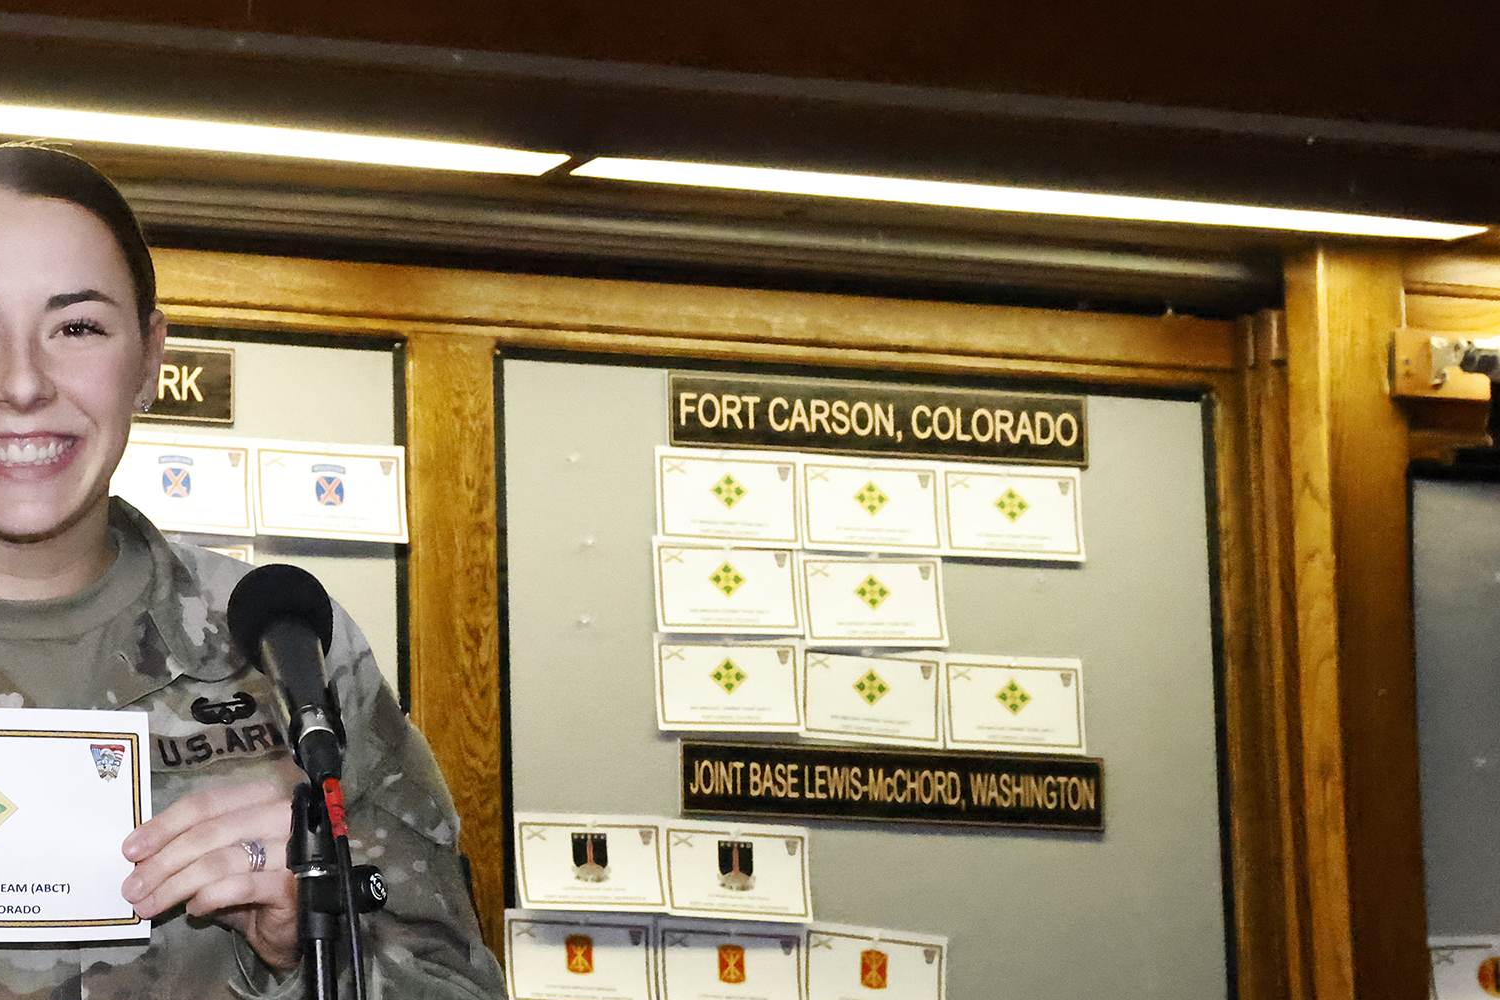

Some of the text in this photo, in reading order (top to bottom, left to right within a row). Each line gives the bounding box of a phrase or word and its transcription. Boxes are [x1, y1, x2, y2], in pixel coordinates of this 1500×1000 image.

[157, 364, 204, 402] RK
[679, 391, 1078, 447] FORT CARSON, COLORADO
[157, 723, 286, 767] U.S.AR
[689, 758, 1095, 811] JOINT BASE LEWIS-McCHORD, WASHINGTON
[30, 883, 71, 895] (ABCT)
